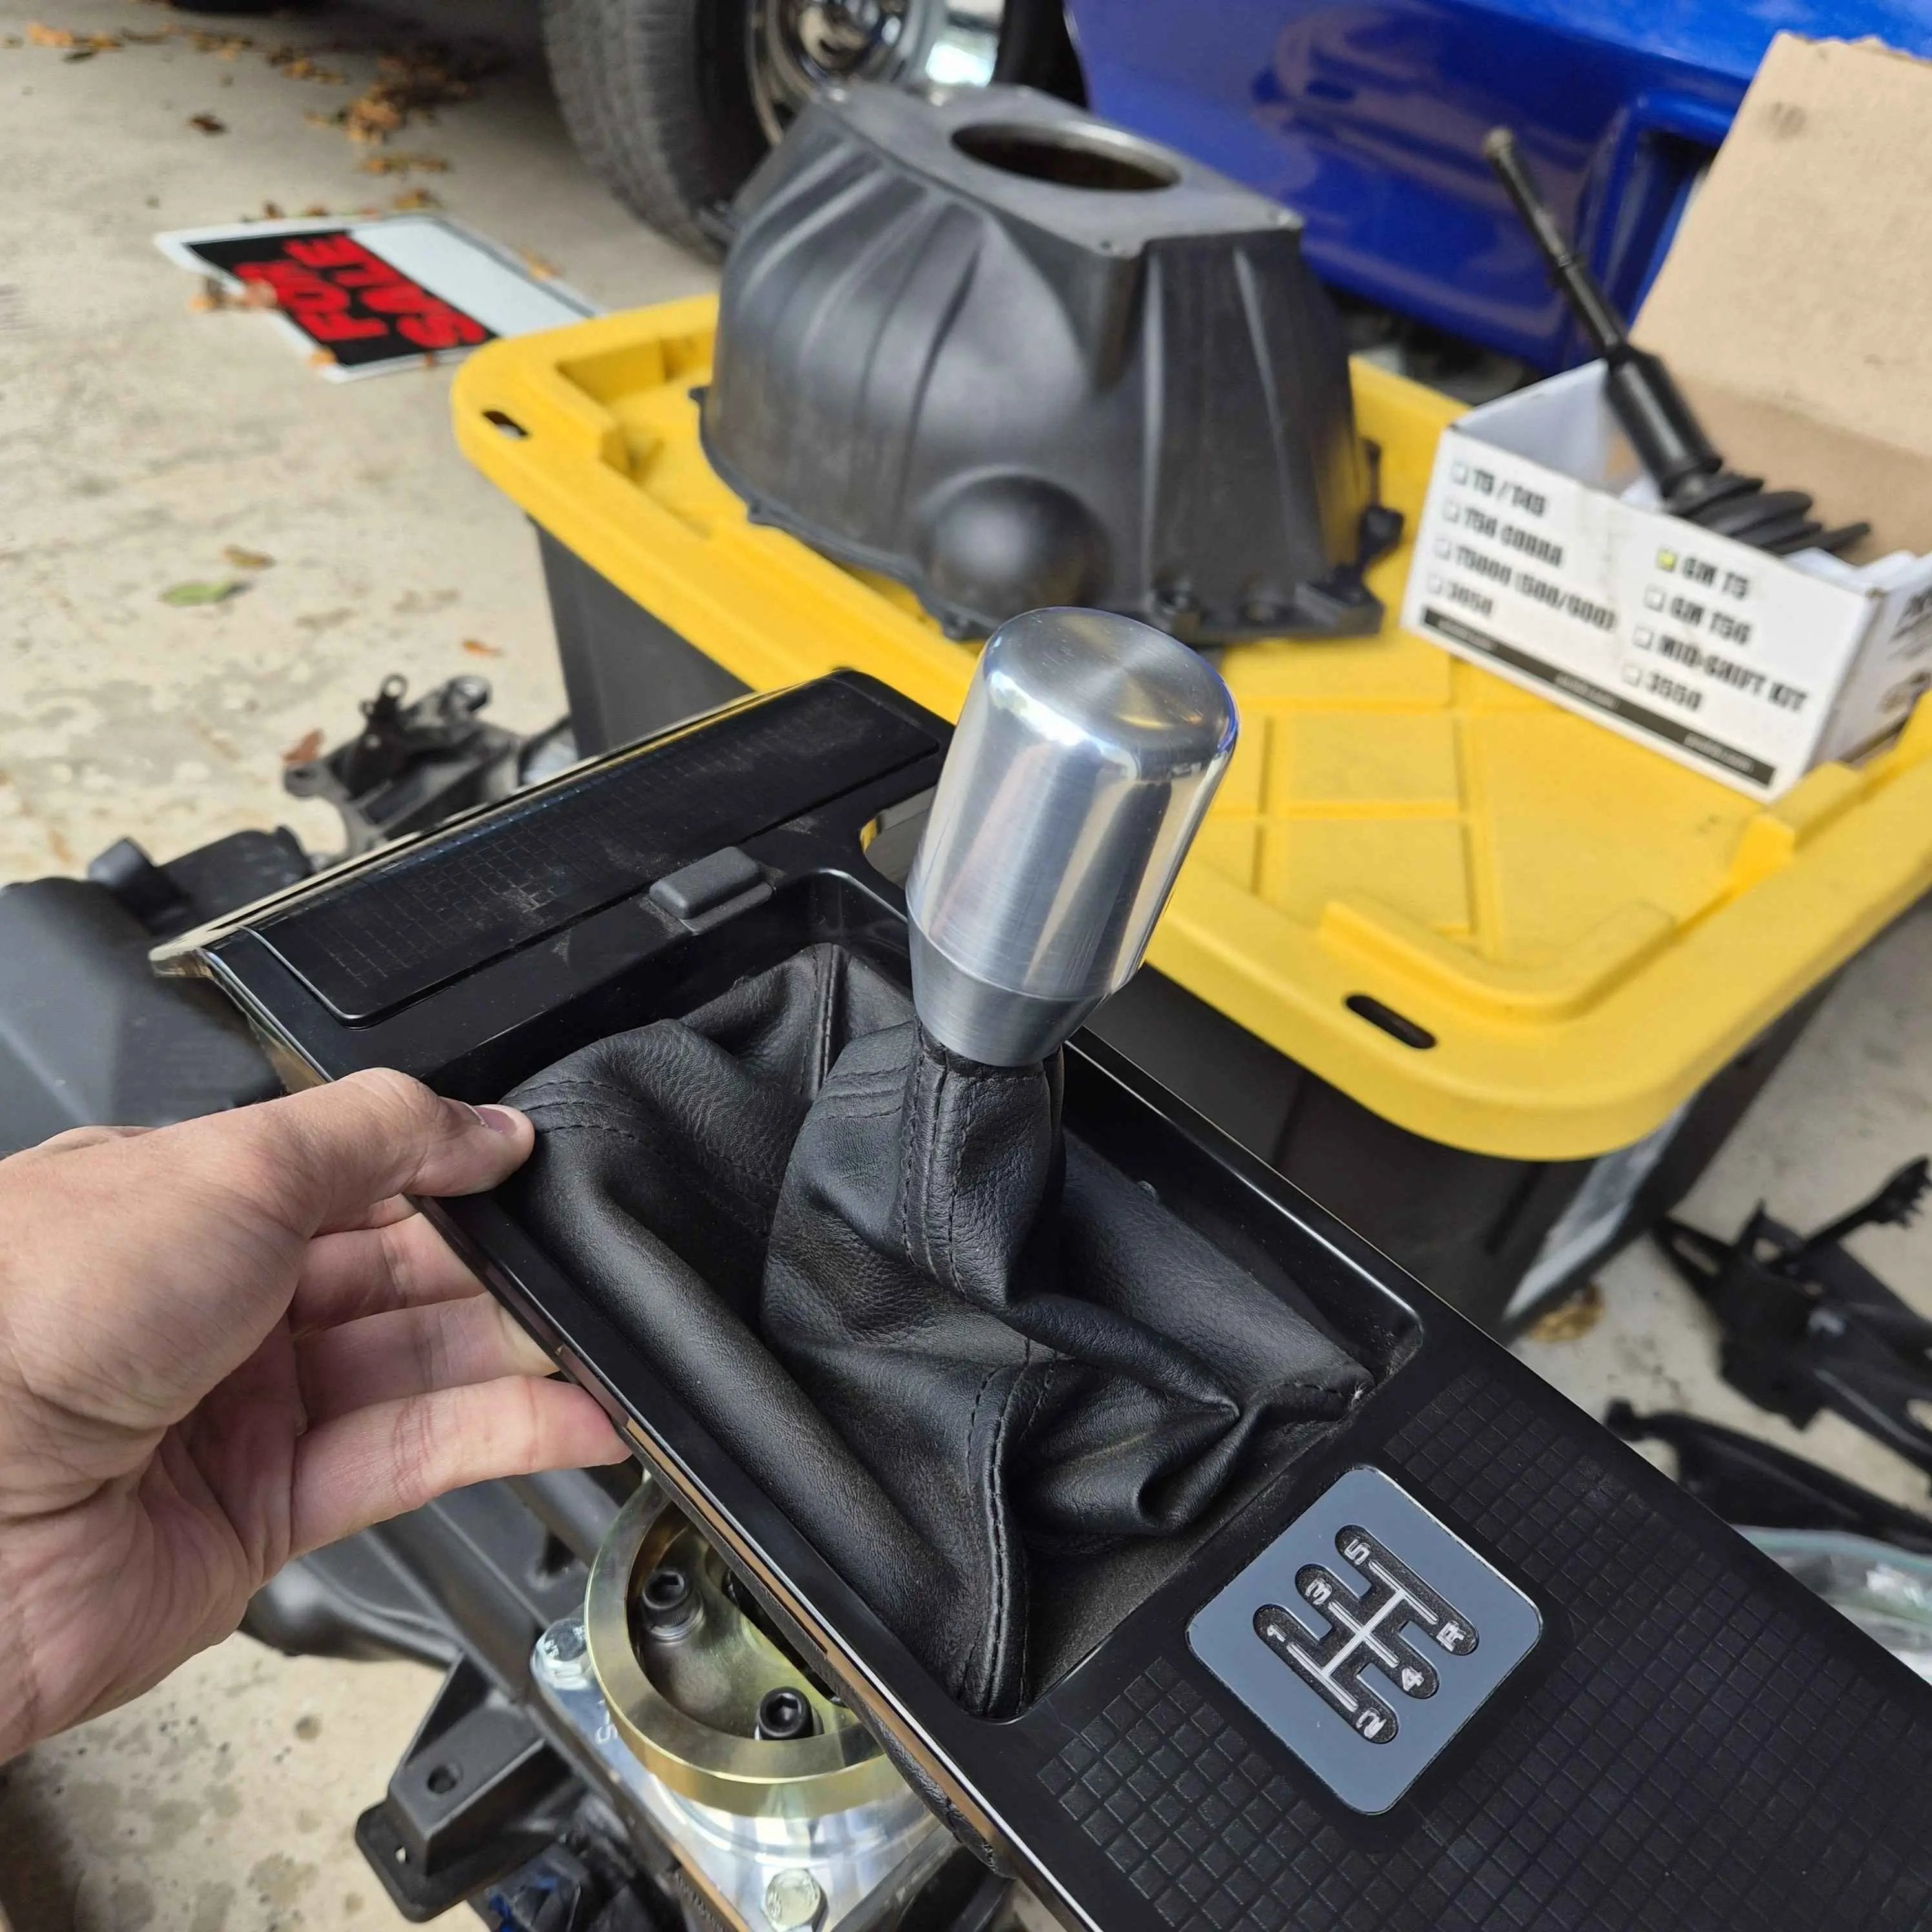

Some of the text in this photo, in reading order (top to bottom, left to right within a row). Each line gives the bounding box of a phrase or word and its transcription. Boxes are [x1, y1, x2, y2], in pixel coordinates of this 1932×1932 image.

[234, 259, 387, 340] FOR
[283, 236, 485, 349] SALE
[1501, 525, 1563, 567] COBRA
[1683, 557, 1749, 599] GM T5
[1670, 597, 1751, 645] GM T56
[1769, 683, 1807, 712] KIT
[1344, 1539, 1371, 1565] 5
[1306, 1578, 1332, 1605] 3
[1267, 1624, 1287, 1642] 1
[1437, 1621, 1467, 1652] R
[1402, 1668, 1424, 1691] 4
[1357, 1707, 1386, 1738] 2
